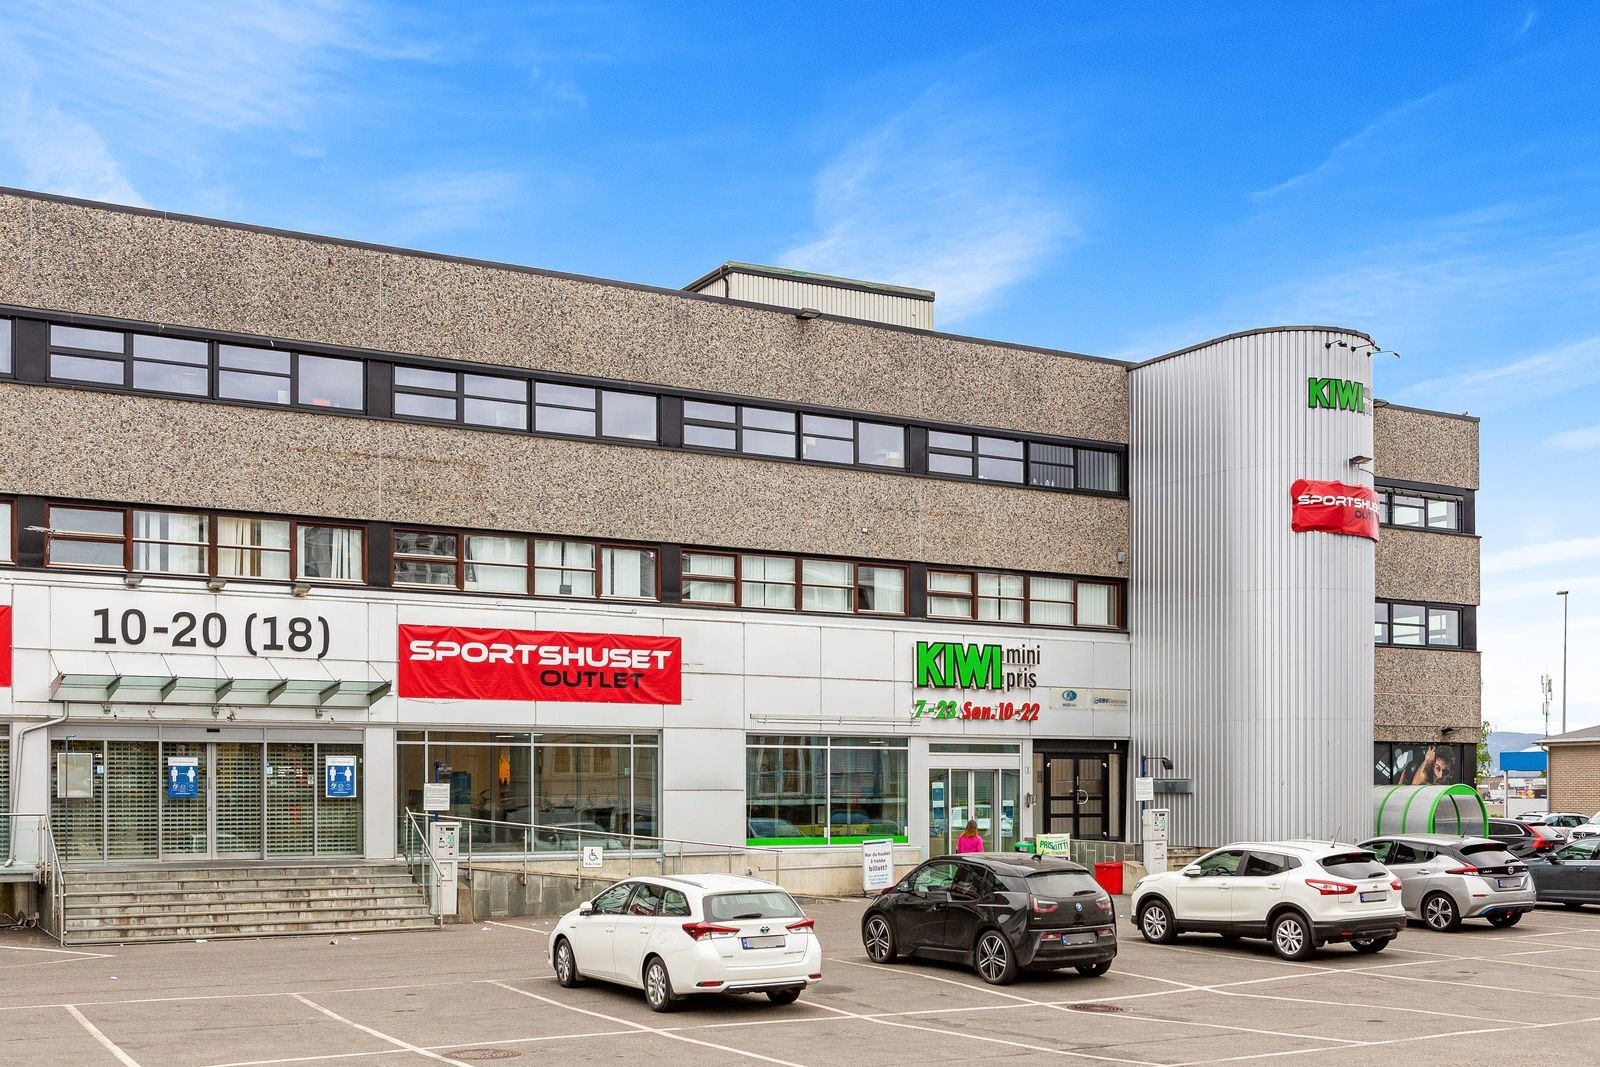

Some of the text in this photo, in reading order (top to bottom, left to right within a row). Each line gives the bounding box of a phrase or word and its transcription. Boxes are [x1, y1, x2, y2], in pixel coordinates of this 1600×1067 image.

[1308, 377, 1364, 413] KIWI
[93, 607, 331, 660] 10-20 (18)
[408, 639, 673, 670] SPORTSHUSET
[915, 640, 1003, 690] KIWI
[1006, 643, 1041, 665] mini
[539, 668, 646, 689] OUTLET
[1006, 667, 1038, 692] pris
